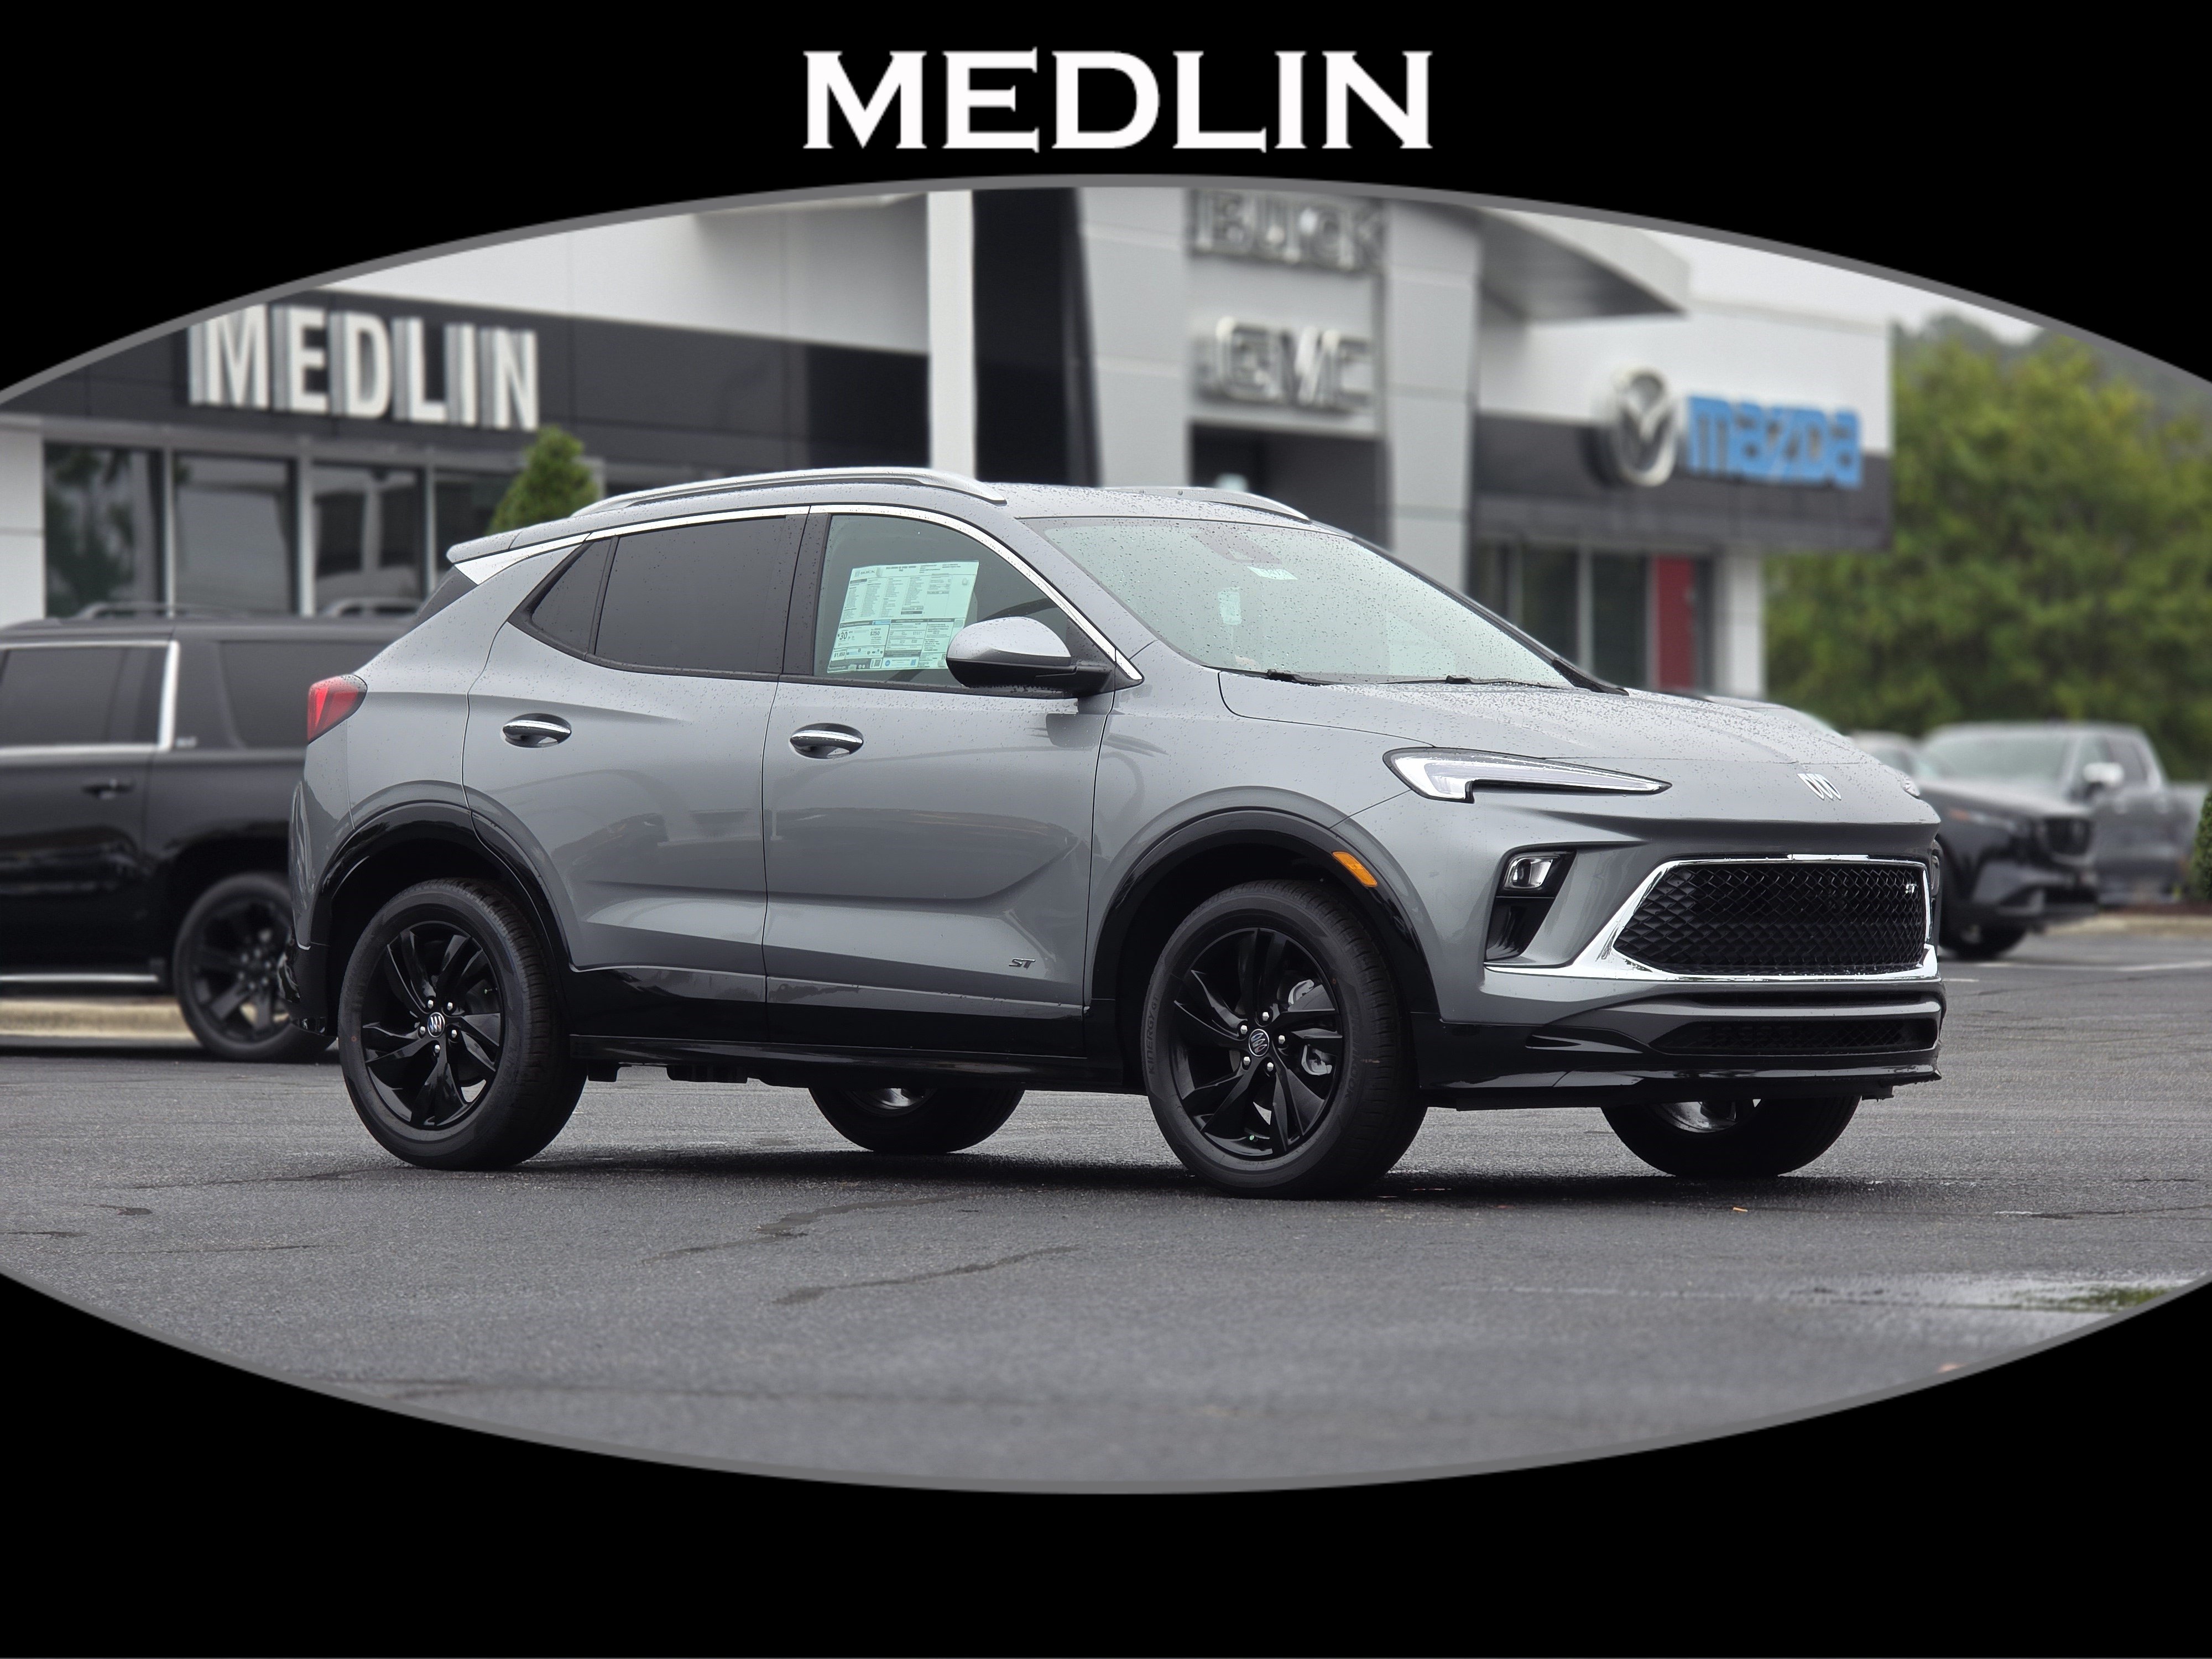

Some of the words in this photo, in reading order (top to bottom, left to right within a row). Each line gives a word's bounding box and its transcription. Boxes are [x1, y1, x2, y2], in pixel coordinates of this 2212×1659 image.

[189, 304, 538, 431] MEDLIN
[1686, 394, 1862, 490] mazda
[1008, 957, 1036, 969] ST
